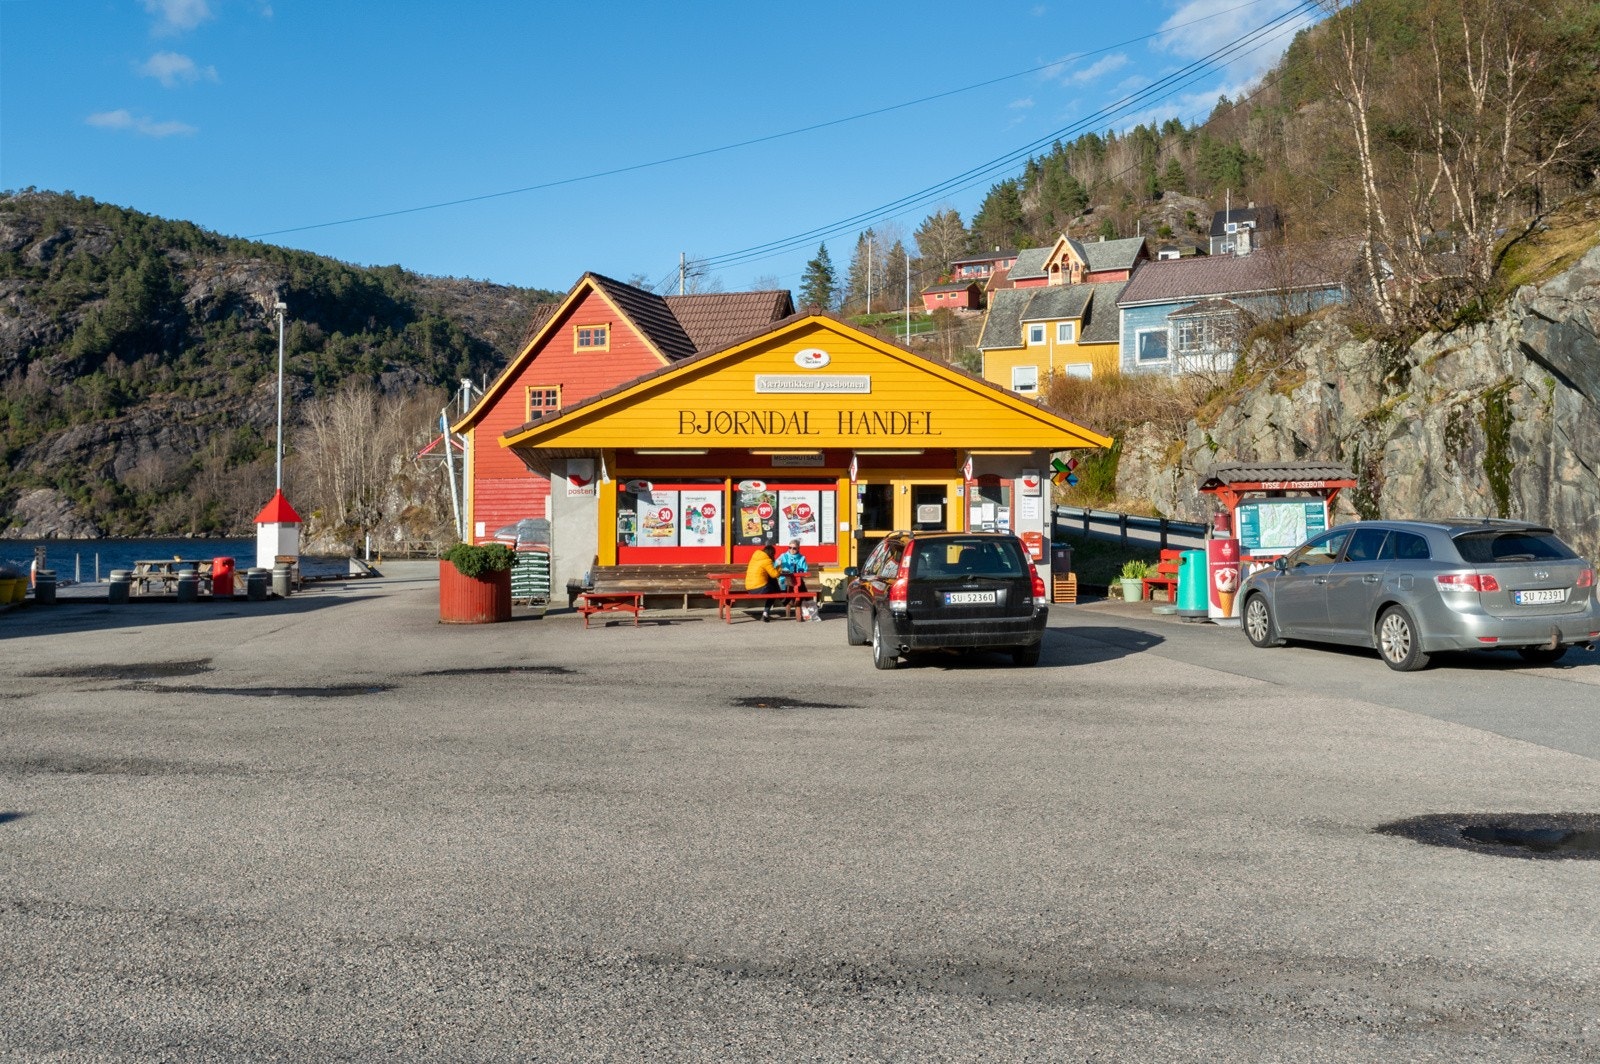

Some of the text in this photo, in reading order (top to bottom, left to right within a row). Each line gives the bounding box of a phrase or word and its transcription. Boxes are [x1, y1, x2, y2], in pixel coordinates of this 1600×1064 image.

[761, 380, 814, 389] Nærbutikken
[678, 410, 942, 435] BJØRNDAL HANDEL
[1261, 481, 1280, 489] TYSSE
[660, 510, 670, 520] 30
[951, 593, 993, 602] SU 52360
[1523, 591, 1562, 601] SU 72391
